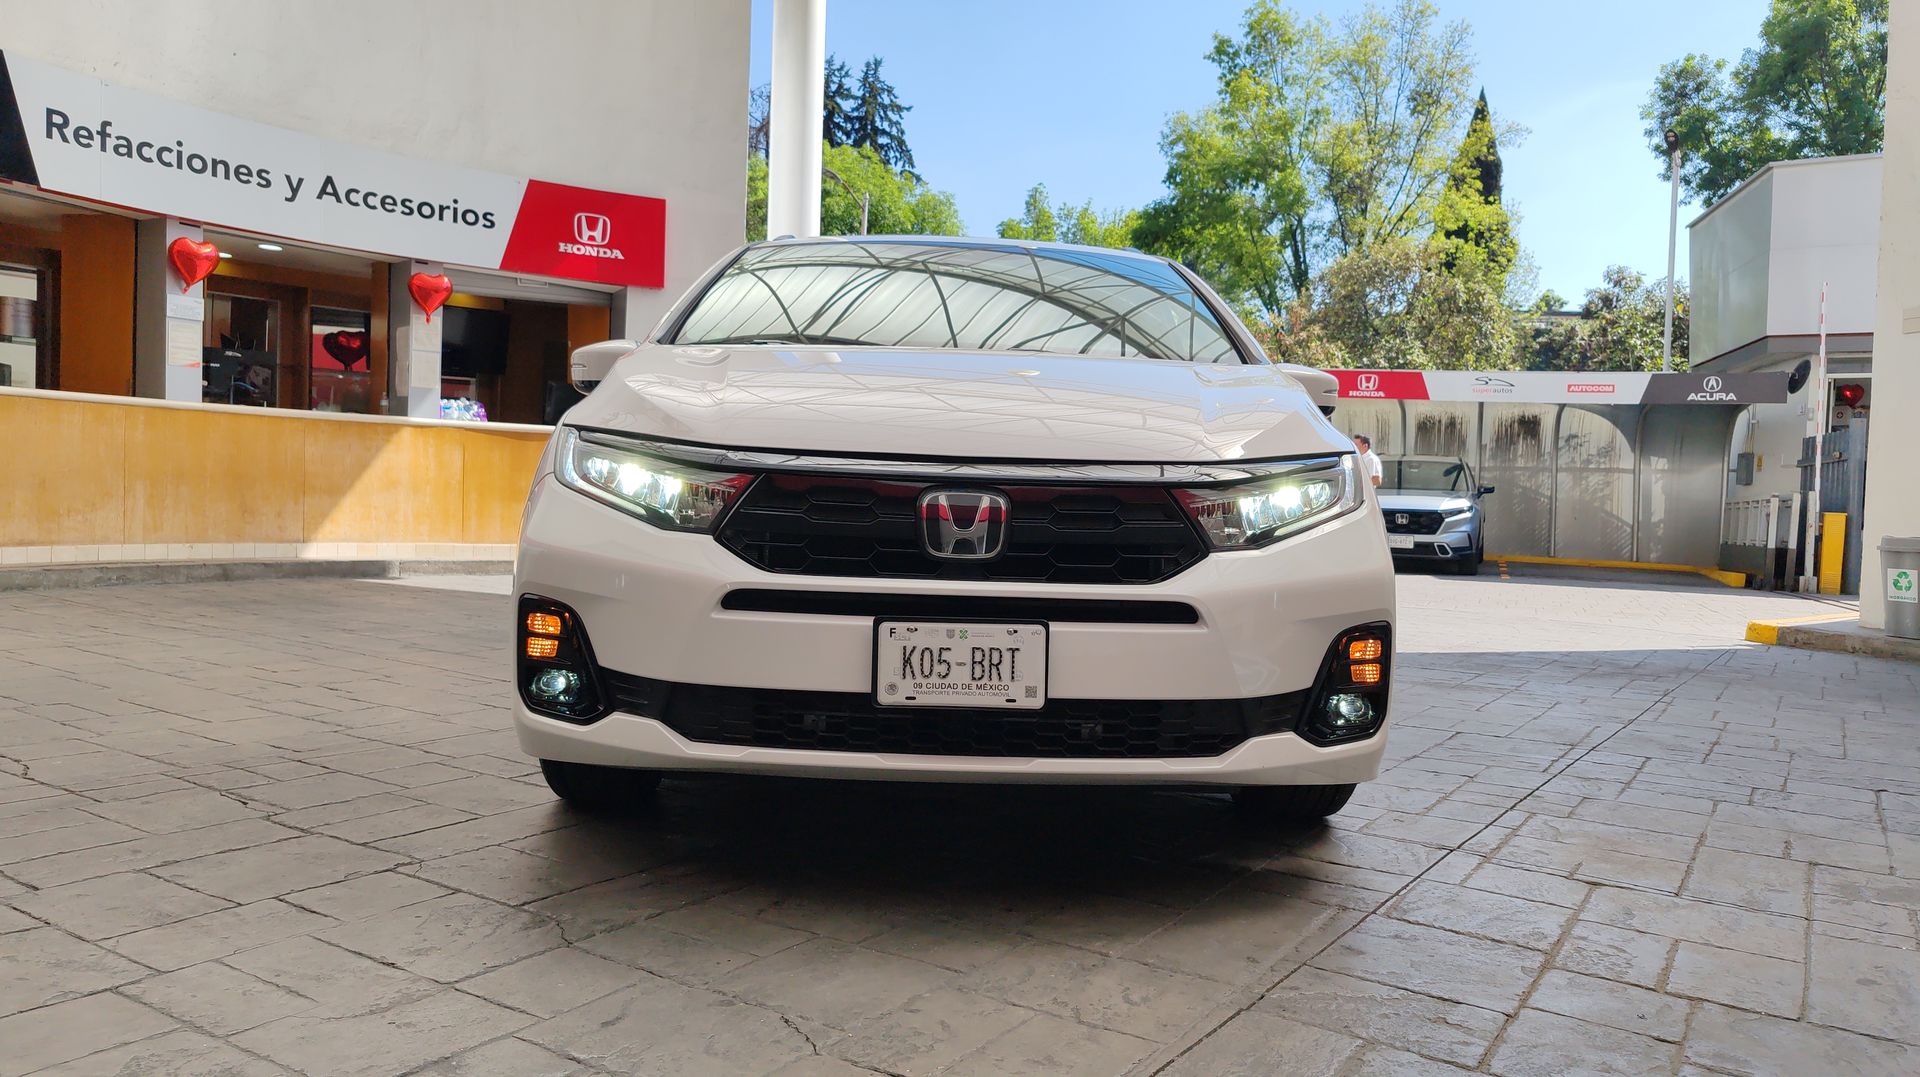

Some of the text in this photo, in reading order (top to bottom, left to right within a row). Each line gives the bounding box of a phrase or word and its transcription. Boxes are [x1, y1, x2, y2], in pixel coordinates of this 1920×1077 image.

[45, 106, 496, 230] Refacciones y Accesorios
[558, 242, 625, 260] HONDA
[1348, 390, 1385, 398] HONDA
[1472, 387, 1513, 395] superautos
[1687, 392, 1737, 401] ACURA
[889, 627, 897, 638] F
[902, 645, 1021, 682] K05-BRT
[912, 682, 1010, 692] 09 CIUDAD DE MÉXICO
